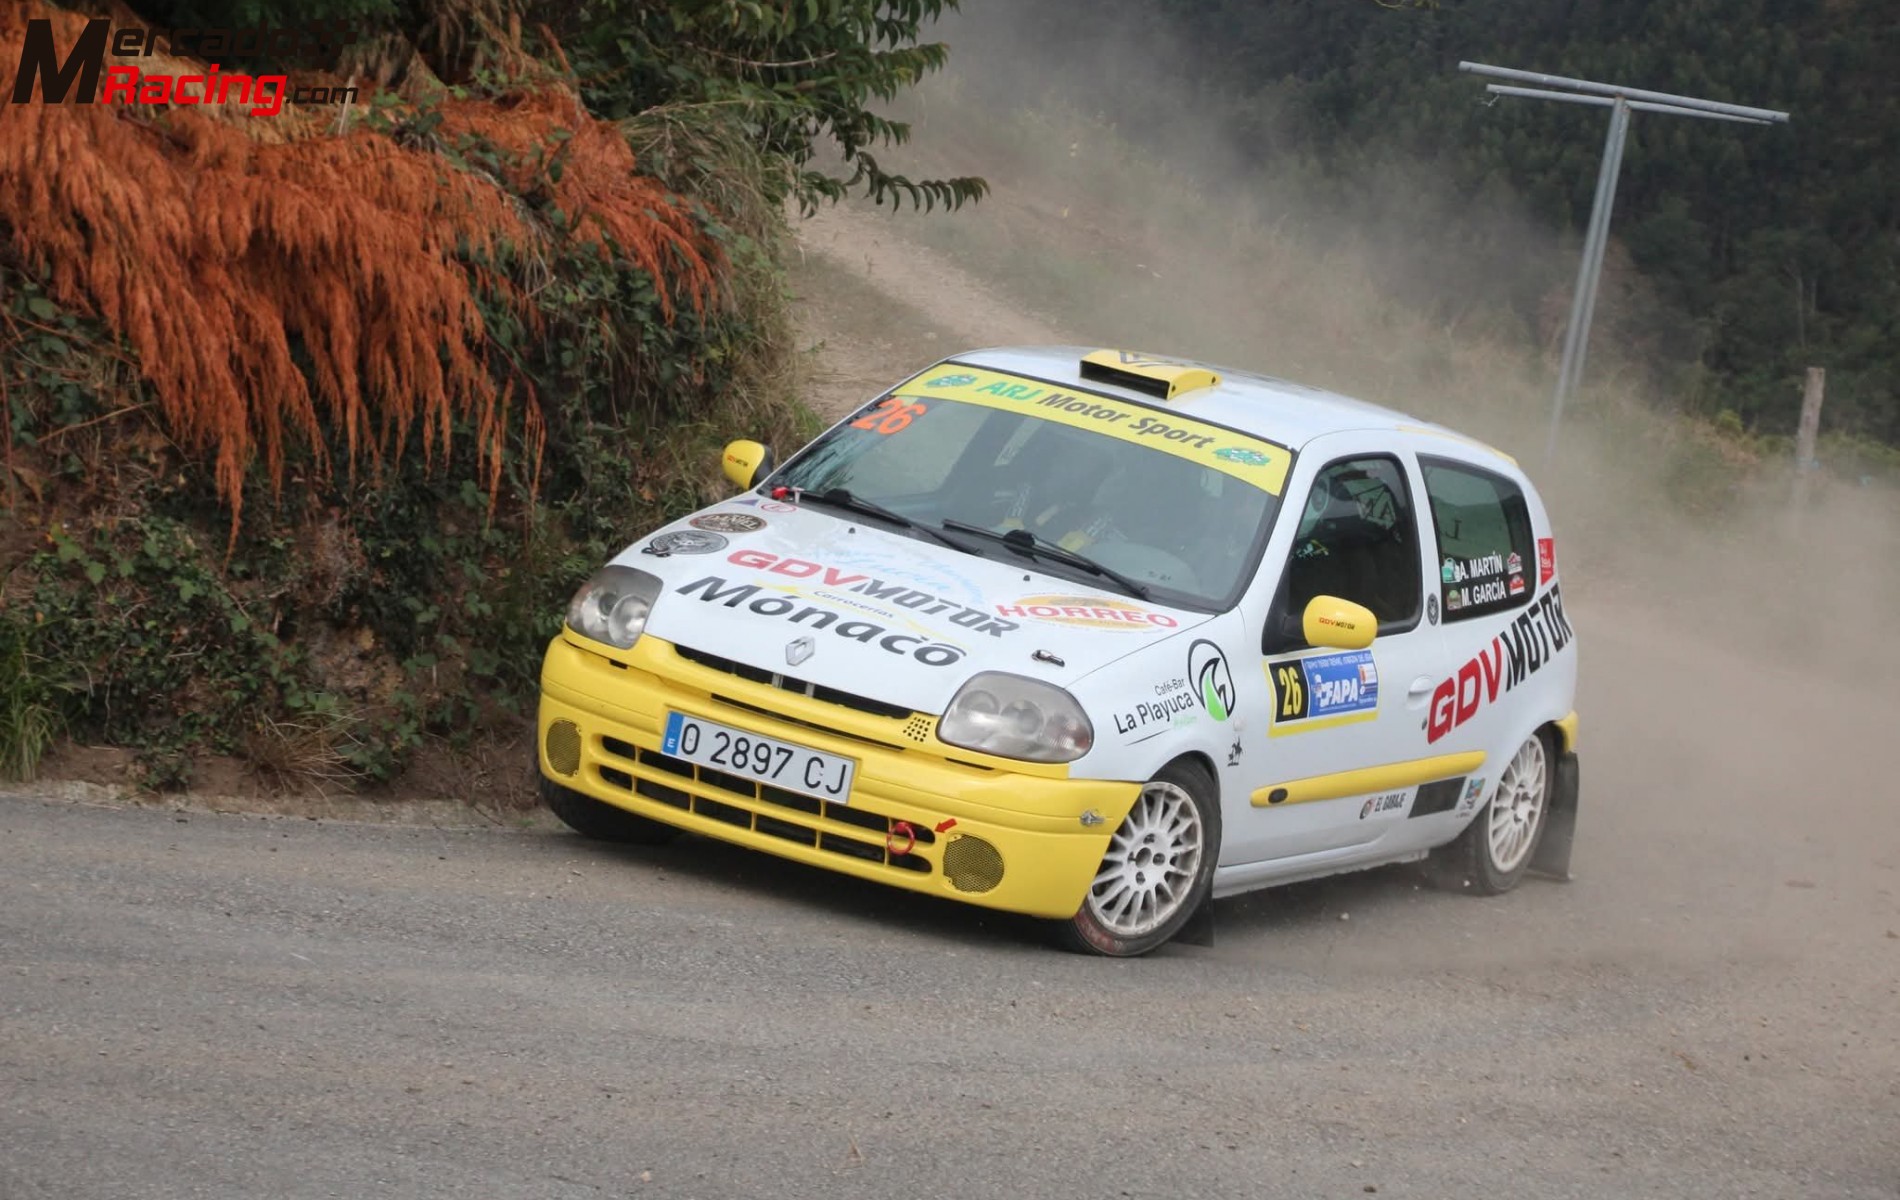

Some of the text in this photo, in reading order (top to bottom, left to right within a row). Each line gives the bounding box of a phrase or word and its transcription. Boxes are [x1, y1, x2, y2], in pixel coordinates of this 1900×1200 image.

[850, 399, 927, 435] 26
[974, 380, 1218, 451] ARJ Motor Sport
[1469, 551, 1503, 578] MARTÍN
[1461, 577, 1507, 607] M. GARCÍA
[676, 576, 962, 667] Mónaco
[995, 604, 1179, 628] HORREO
[1154, 678, 1185, 697] Café-Bar
[1278, 666, 1303, 716] 26
[1113, 712, 1137, 734] La
[1136, 691, 1194, 722] Playuca
[710, 731, 794, 779] 2897
[804, 756, 847, 794] CJ
